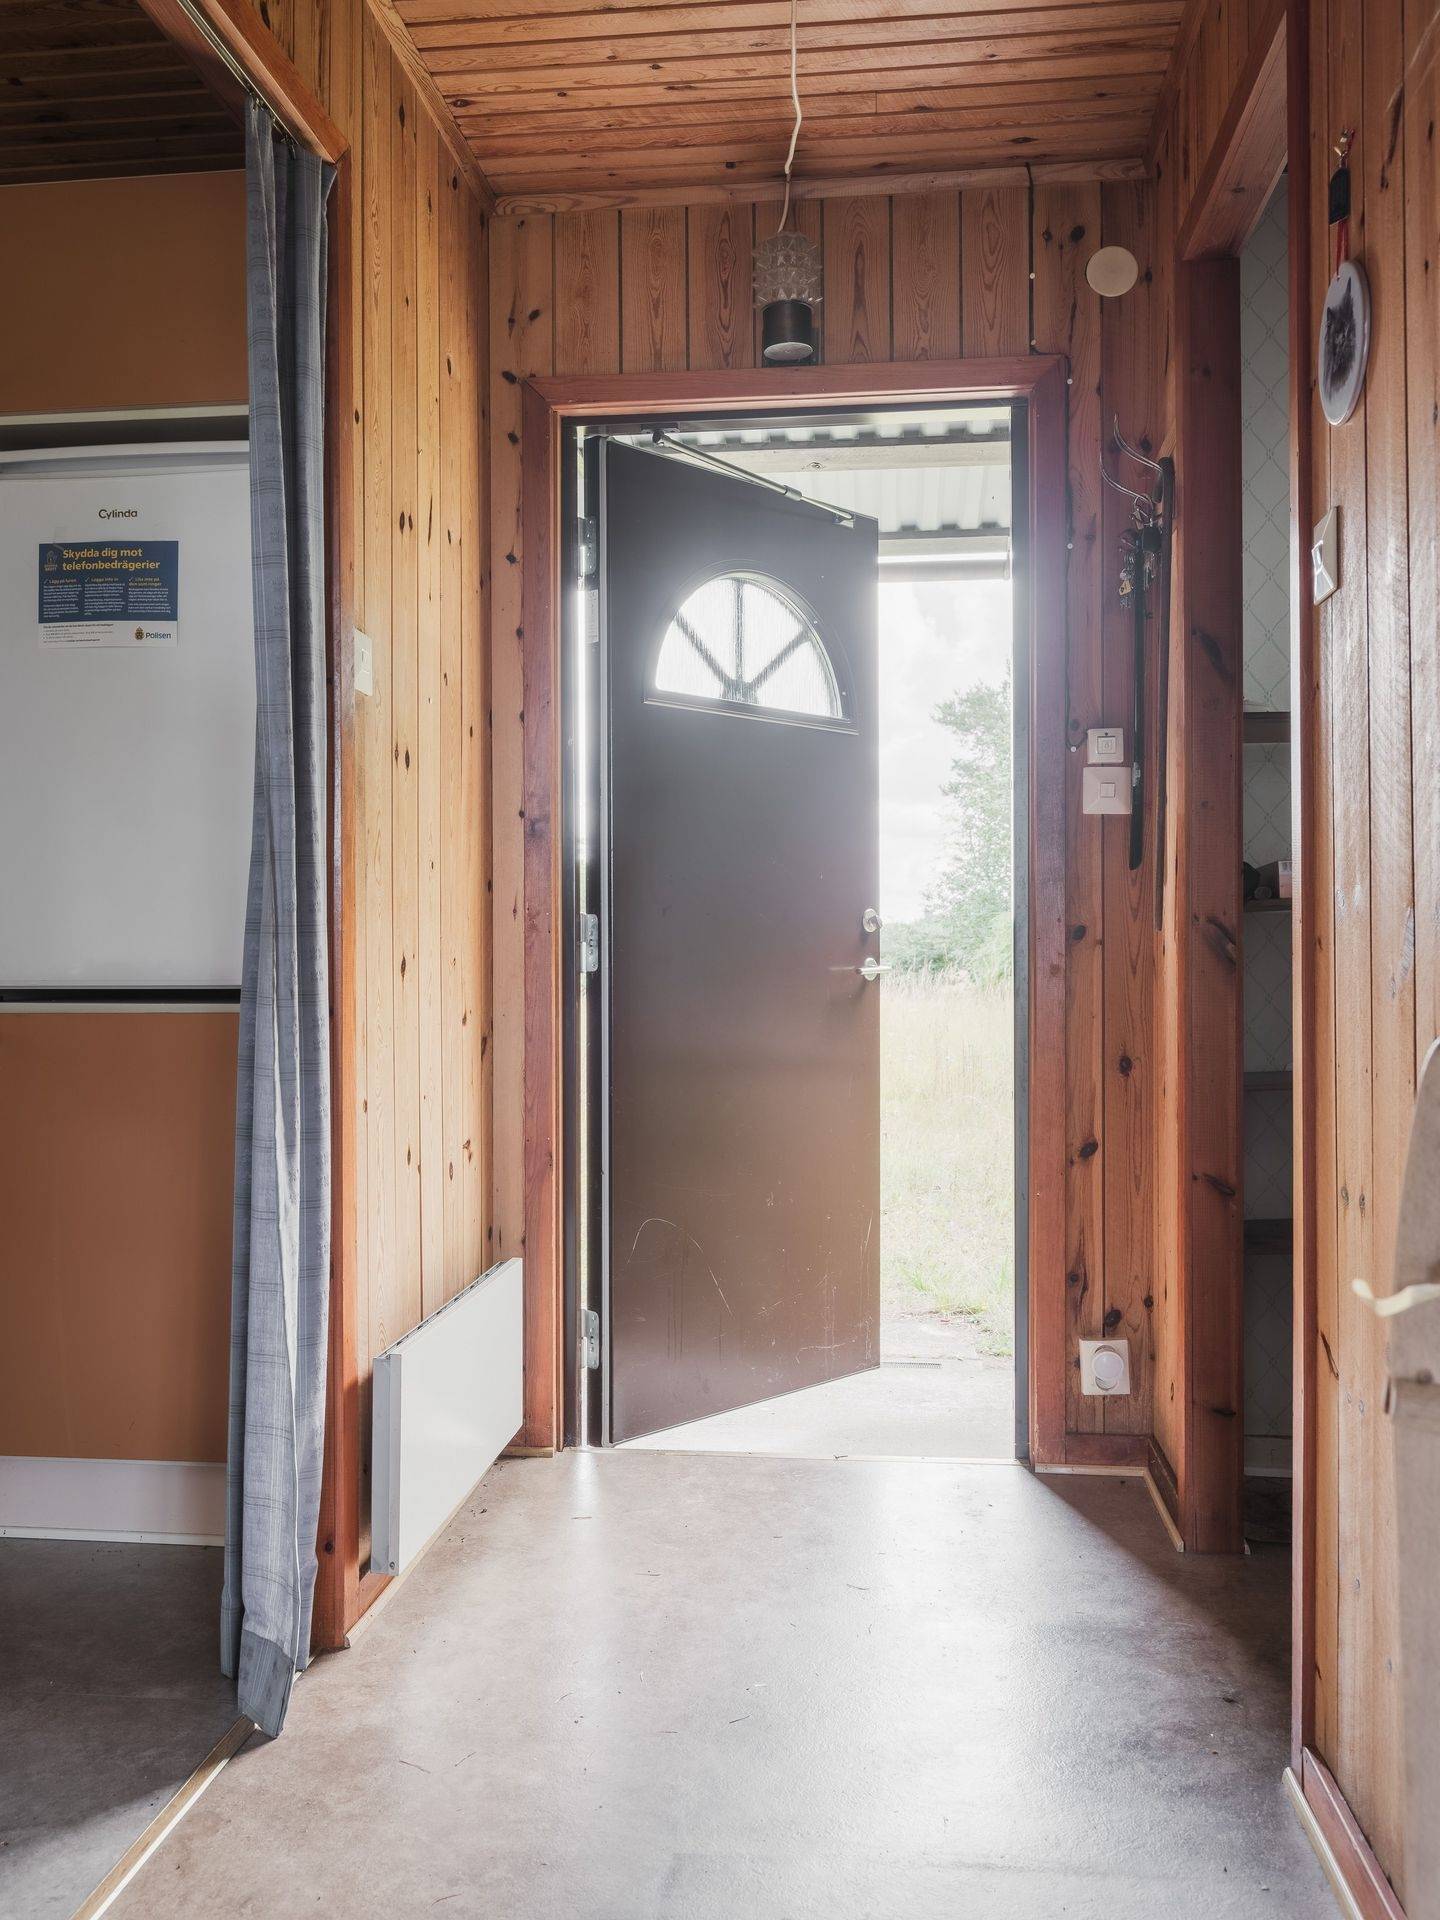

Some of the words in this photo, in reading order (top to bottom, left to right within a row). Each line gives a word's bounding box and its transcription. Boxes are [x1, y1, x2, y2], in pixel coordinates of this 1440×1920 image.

[98, 509, 138, 520] Cylinda
[63, 548, 100, 560] Skydda
[101, 548, 118, 559] dig
[120, 548, 143, 557] mot
[63, 560, 161, 571] telefonbedrägerier
[145, 631, 171, 639] Polisen
